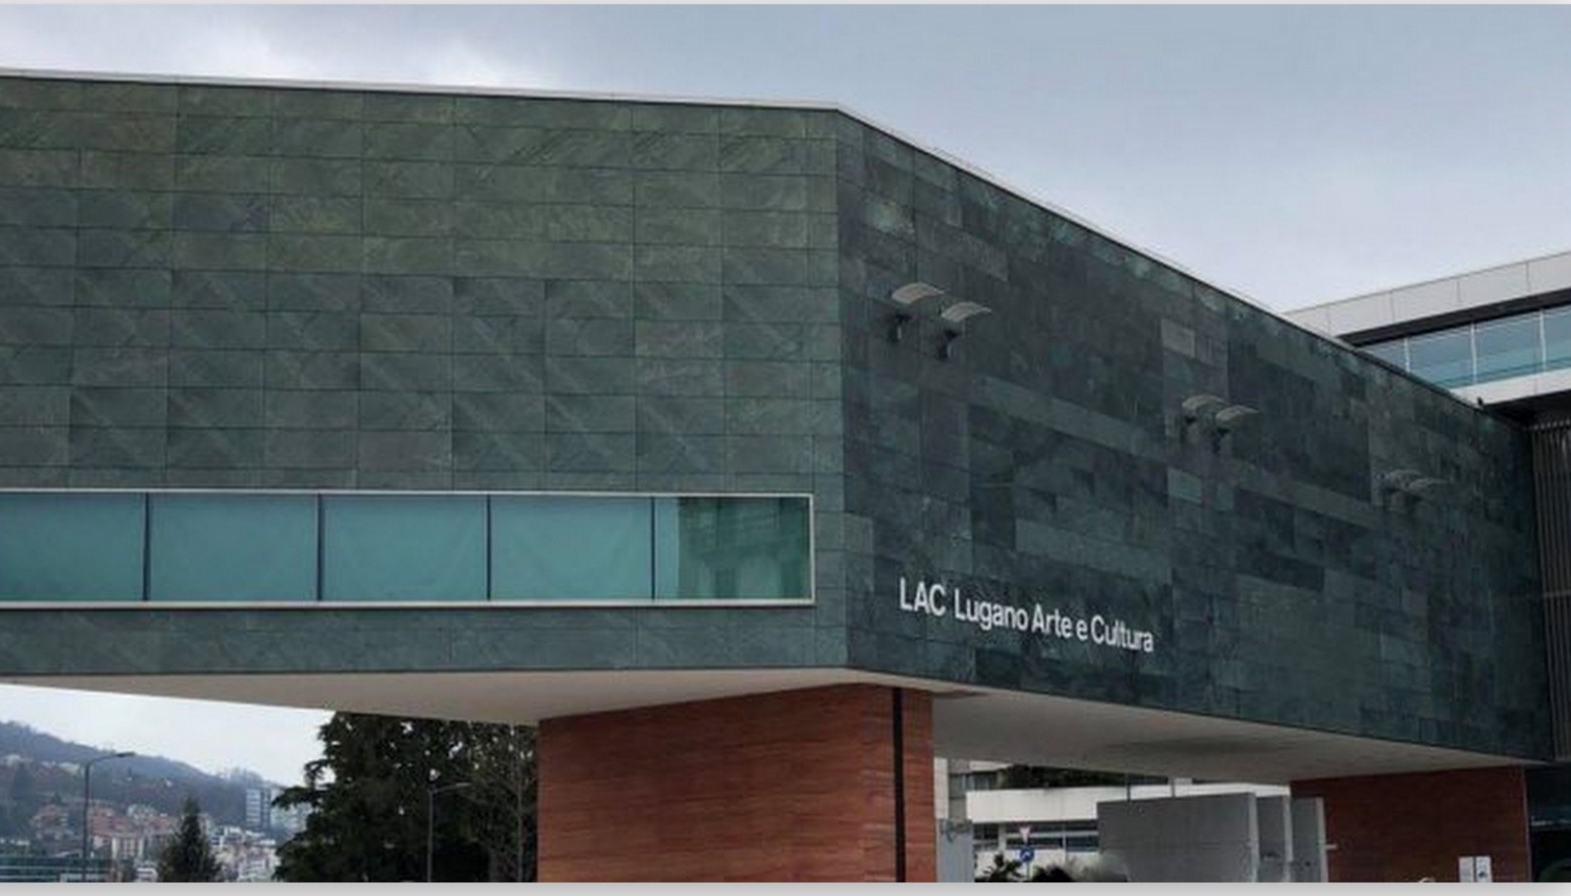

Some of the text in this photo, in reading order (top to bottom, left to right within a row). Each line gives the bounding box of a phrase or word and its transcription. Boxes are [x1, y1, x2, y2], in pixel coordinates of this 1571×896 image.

[900, 577, 1155, 653] LAC Lugano Arte e Cultura
